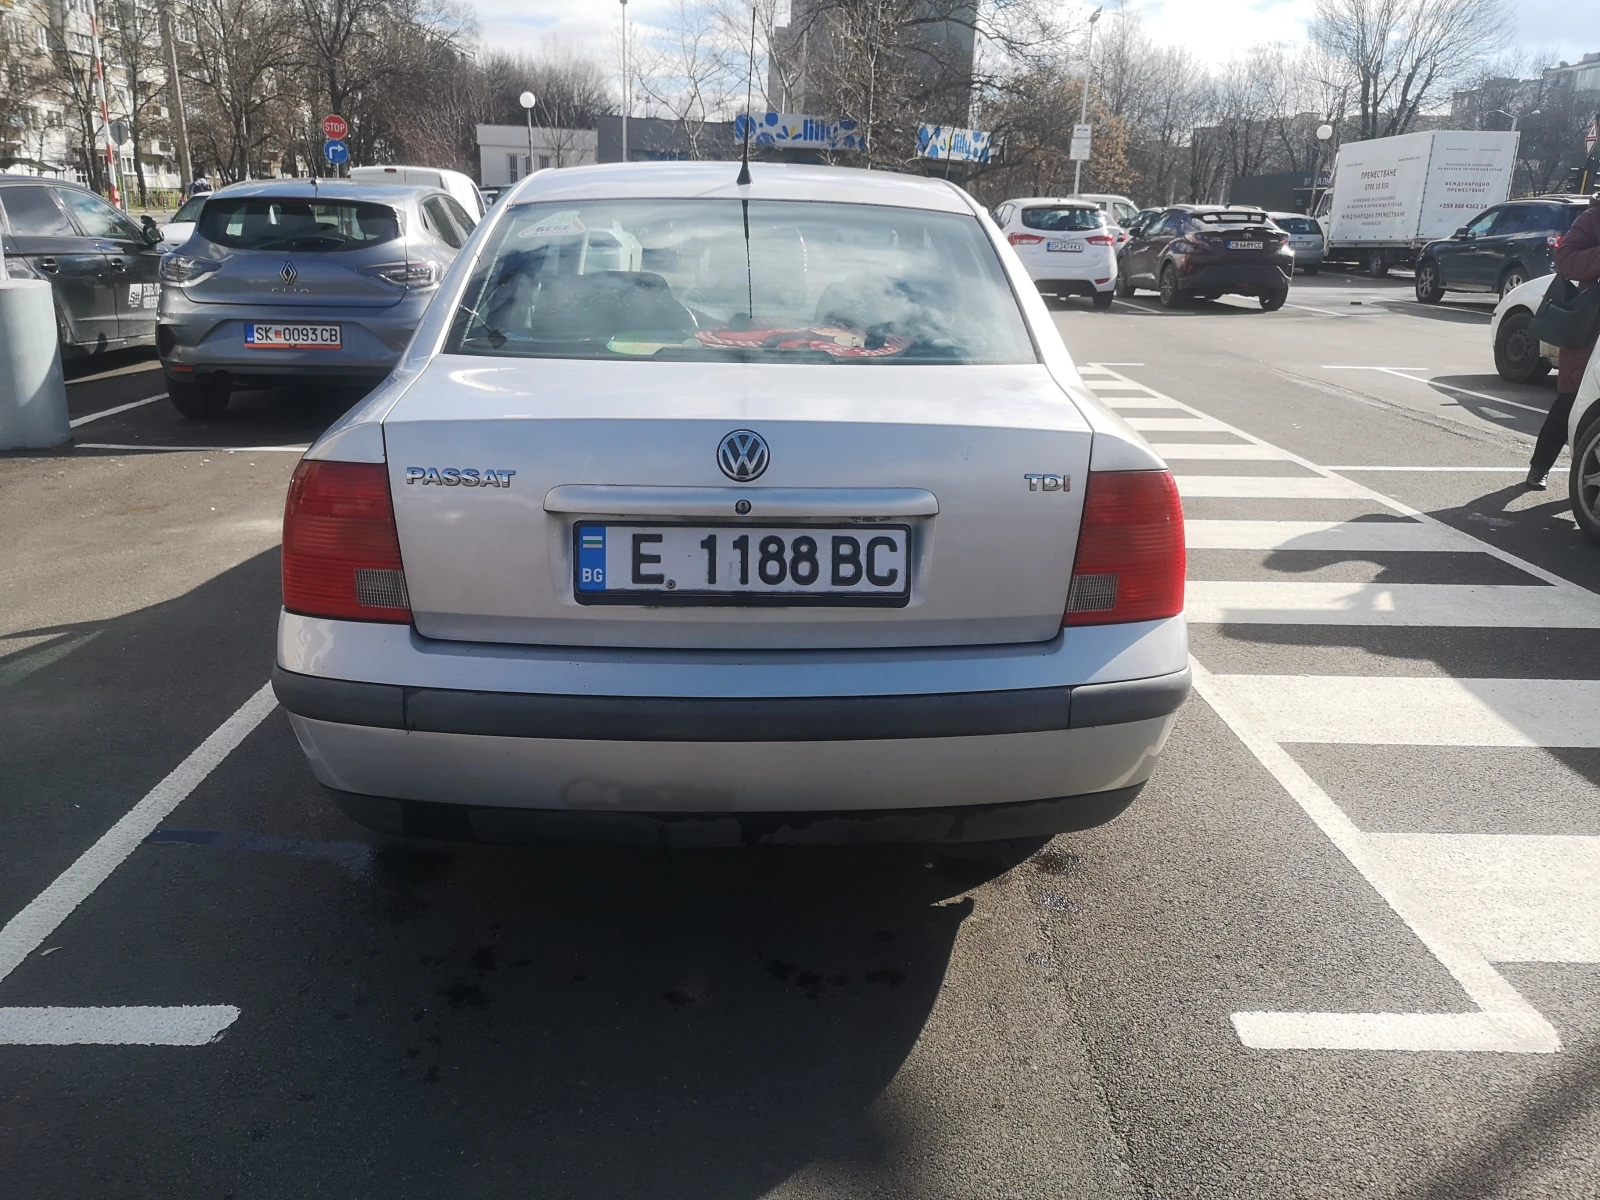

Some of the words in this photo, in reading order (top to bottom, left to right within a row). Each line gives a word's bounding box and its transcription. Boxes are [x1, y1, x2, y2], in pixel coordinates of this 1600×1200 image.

[324, 122, 345, 132] STOP
[803, 119, 838, 148] lilly
[953, 133, 971, 160] lilly
[1360, 169, 1397, 179] ПРЕМЕСТВАНЕ
[255, 327, 273, 341] SK
[283, 327, 318, 342] 0093
[320, 328, 338, 342] CB
[405, 466, 516, 488] PASSAT
[1024, 473, 1071, 492] TDI
[631, 533, 665, 585] E
[700, 534, 819, 587] 1188
[830, 535, 899, 587] BC
[582, 568, 603, 583] BG
